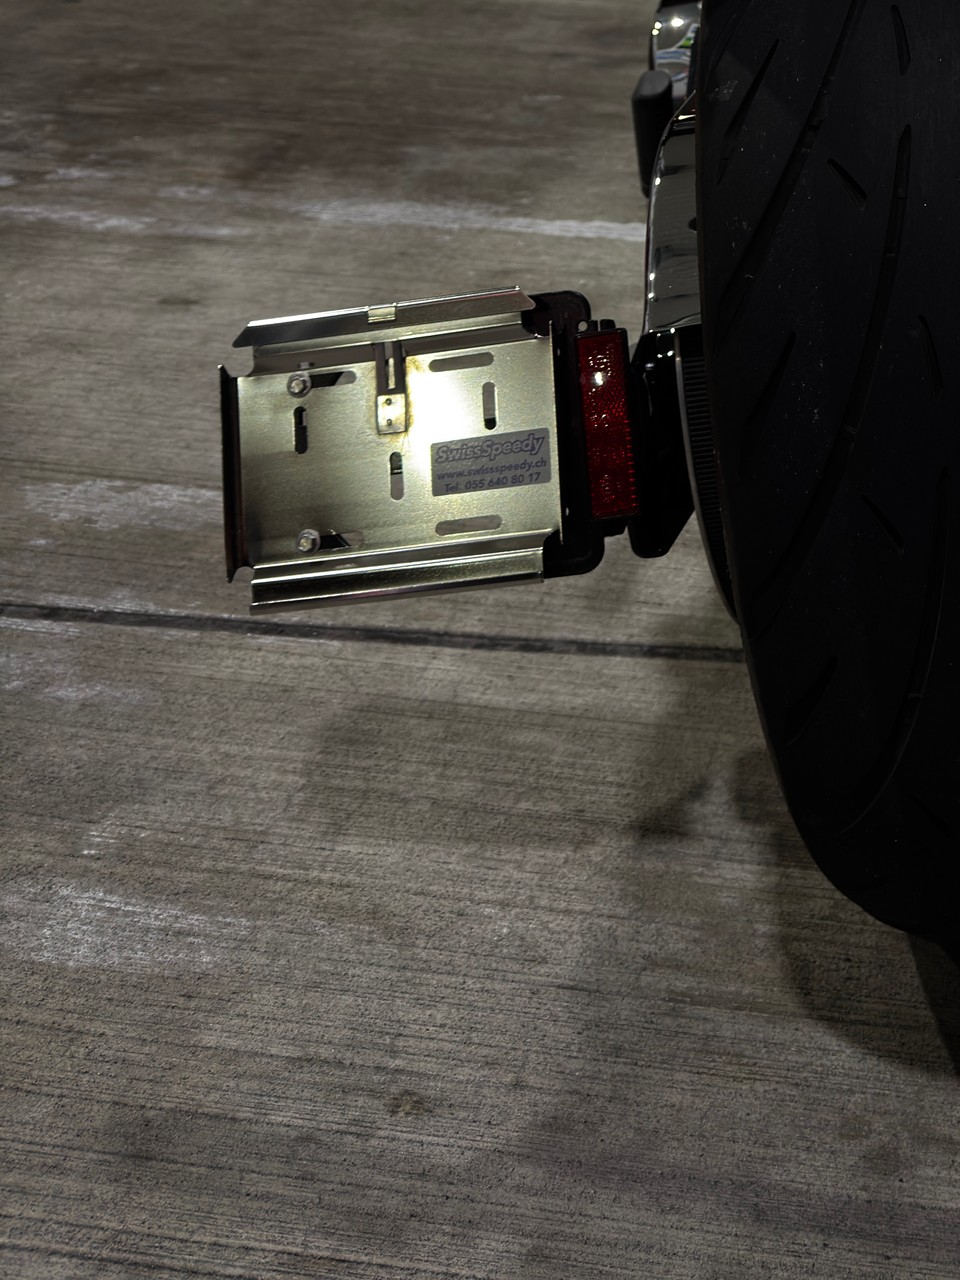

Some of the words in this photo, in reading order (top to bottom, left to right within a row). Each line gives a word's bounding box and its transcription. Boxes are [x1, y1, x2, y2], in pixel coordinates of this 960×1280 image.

[435, 433, 545, 463] SwissSpeedy
[437, 457, 546, 480] www.swissspeedy.ch
[465, 479, 485, 490] 055
[487, 476, 507, 487] 640
[511, 474, 525, 484] 80
[529, 472, 541, 481] 17
